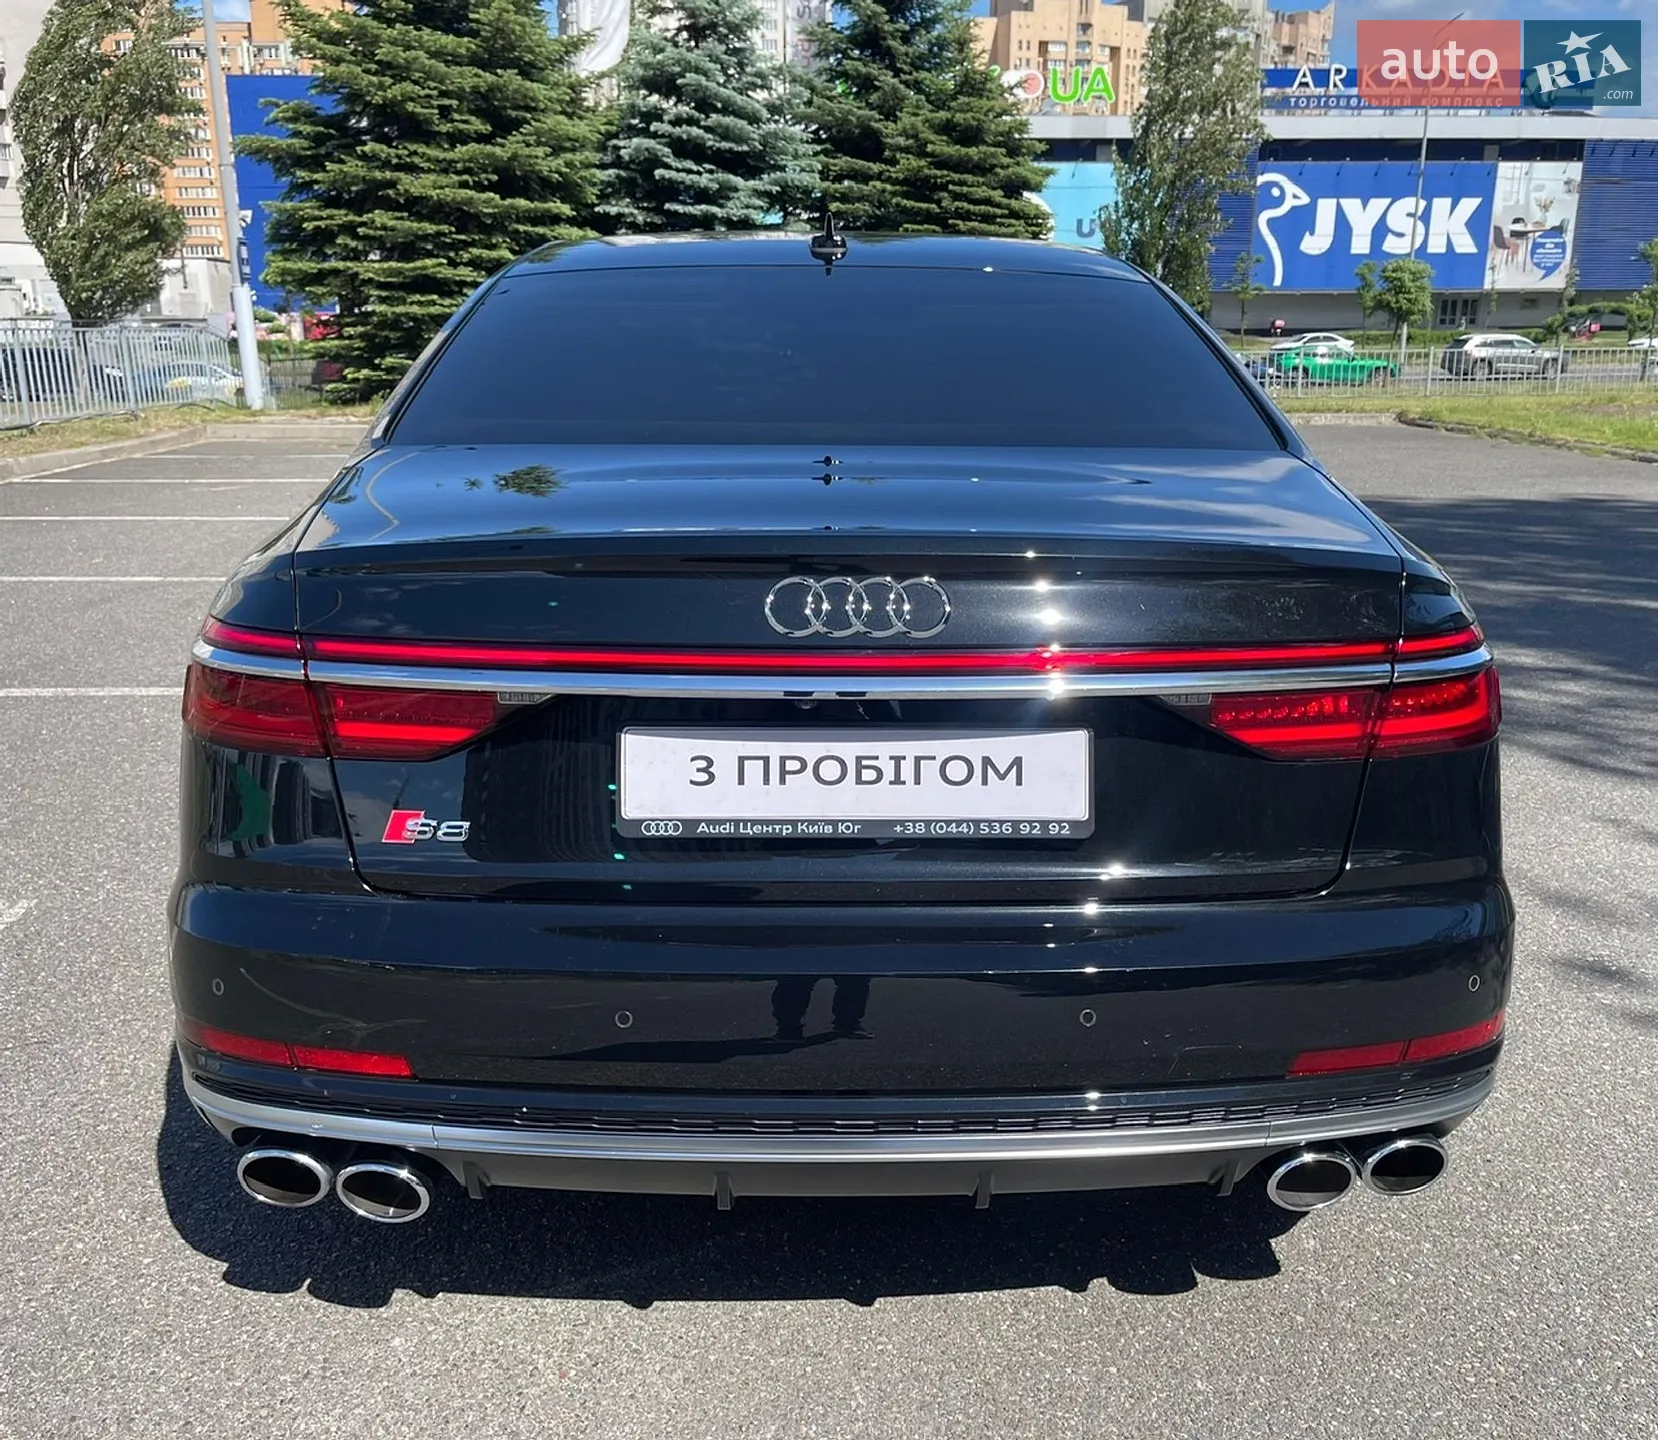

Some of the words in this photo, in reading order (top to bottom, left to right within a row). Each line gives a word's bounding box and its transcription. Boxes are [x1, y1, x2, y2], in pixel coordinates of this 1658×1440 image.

[1299, 196, 1483, 255] JYSK
[737, 754, 1023, 787] ПРОБІГОМ
[402, 817, 471, 842] S8
[697, 821, 735, 834] Audi
[740, 822, 793, 836] Центр
[798, 821, 833, 834] Київ
[838, 822, 861, 834] Юг
[893, 822, 926, 834] +38
[930, 821, 975, 836] (044)
[979, 822, 1013, 834] 536
[1020, 822, 1042, 834] 92
[1049, 822, 1071, 834] 92
